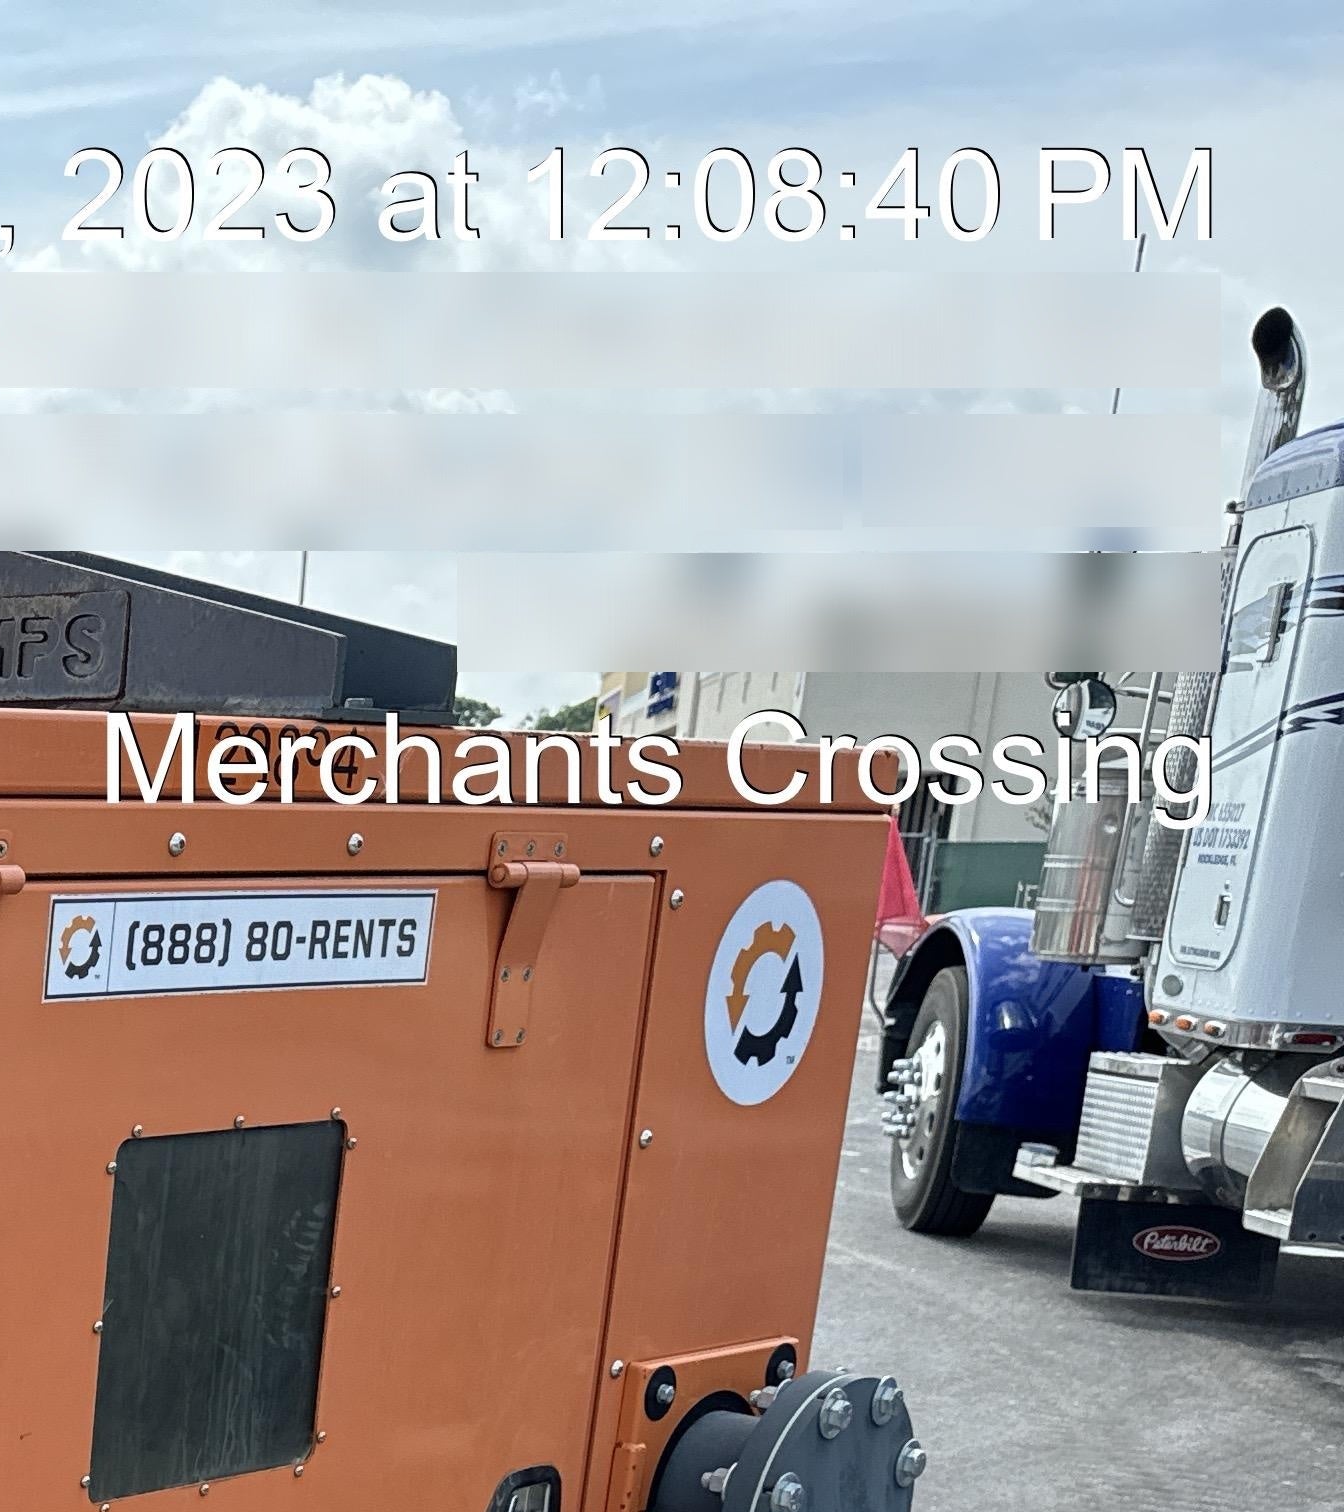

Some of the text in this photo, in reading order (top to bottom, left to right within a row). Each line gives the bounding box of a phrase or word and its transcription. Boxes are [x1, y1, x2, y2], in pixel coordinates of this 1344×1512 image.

[125, 917, 418, 971] (888) 80-RENTS
[1143, 1230, 1213, 1255] Peterbilt
